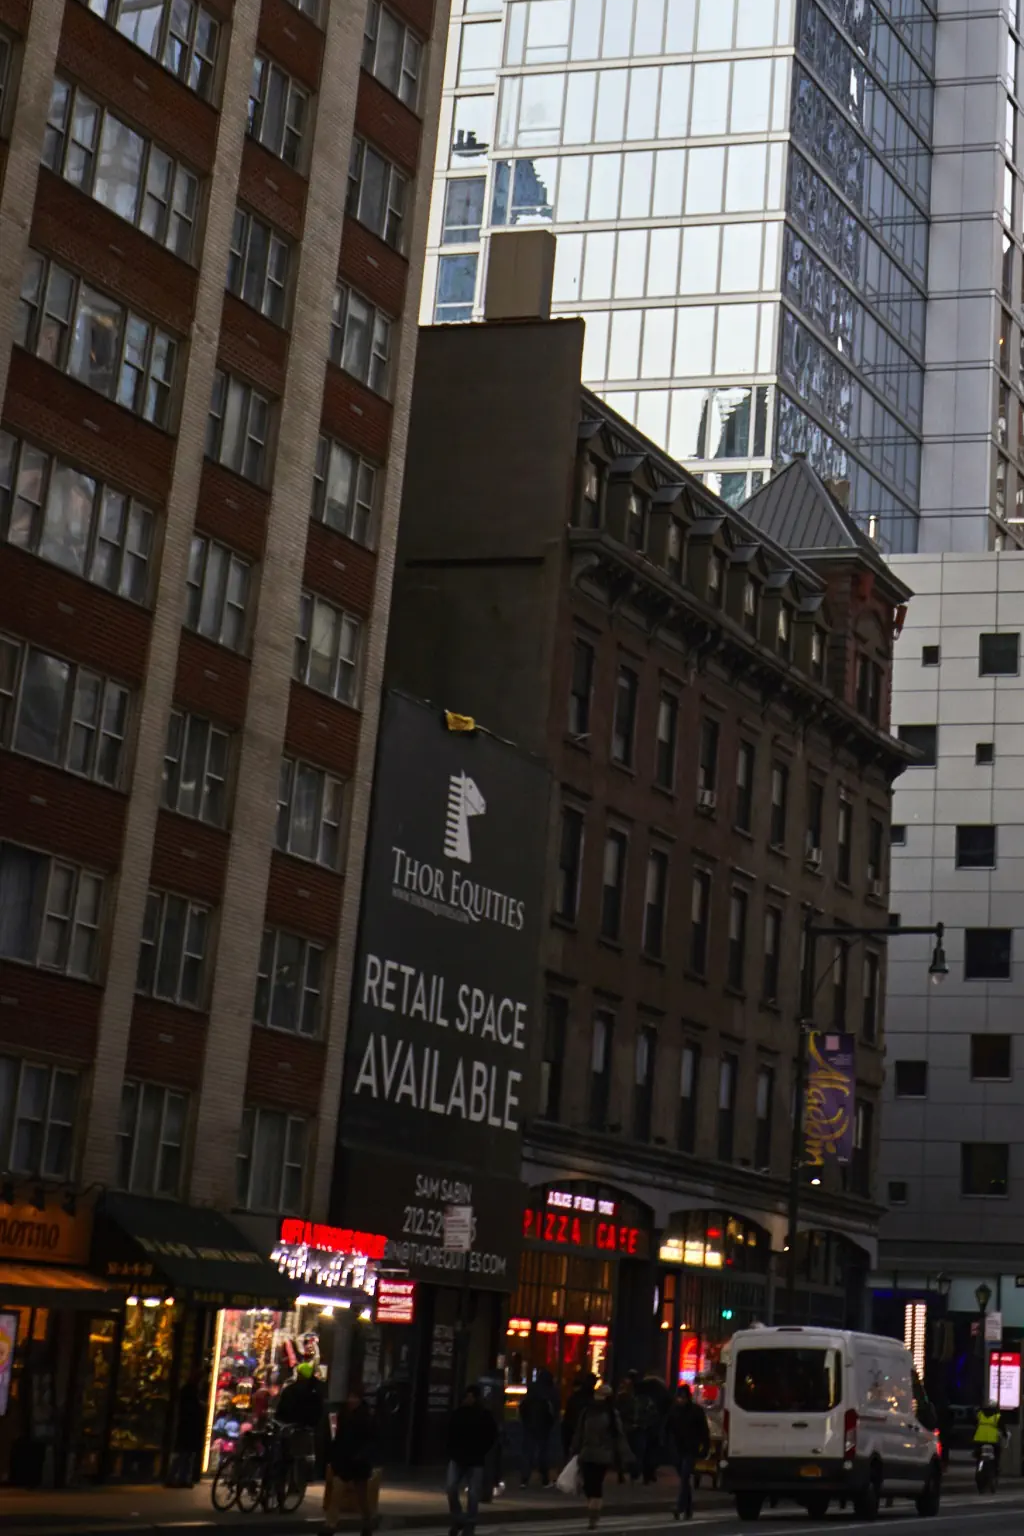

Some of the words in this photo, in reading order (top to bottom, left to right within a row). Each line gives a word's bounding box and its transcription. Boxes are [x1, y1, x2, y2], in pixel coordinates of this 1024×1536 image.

[392, 846, 445, 901] THOR
[448, 869, 525, 931] EQUITIES
[363, 954, 448, 1027] RETAIL
[456, 983, 527, 1050] SPACE
[353, 1032, 522, 1132] AVAILABLE
[414, 1173, 440, 1201] SAM
[523, 1208, 581, 1245] PIZZA
[596, 1223, 639, 1254] CAFE
